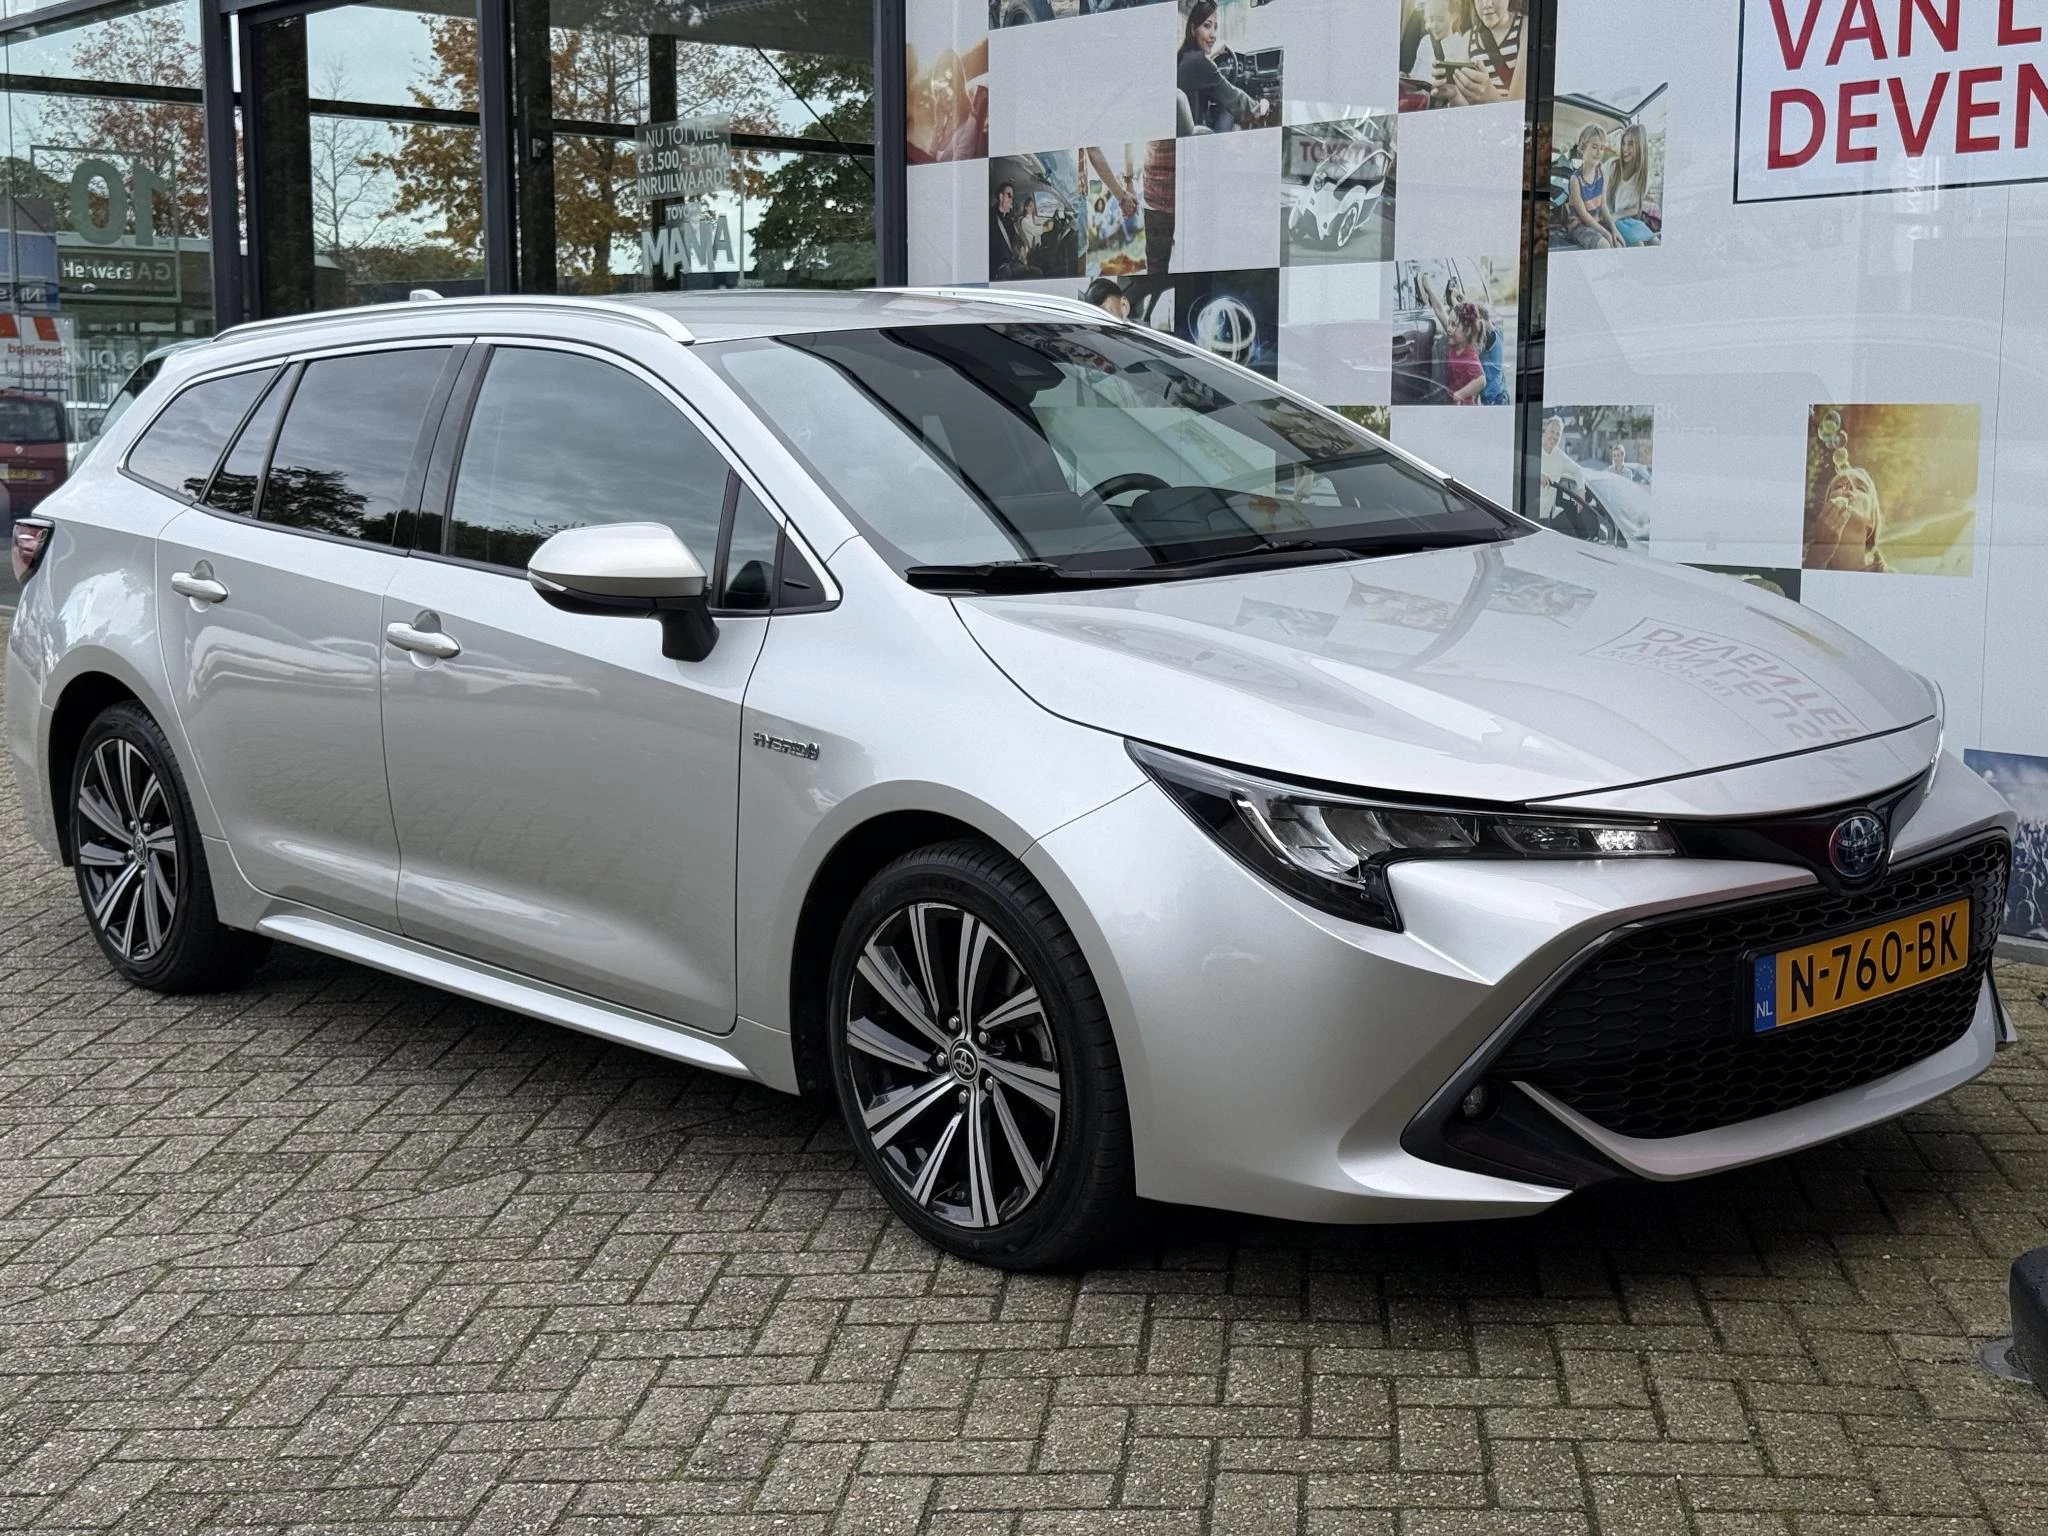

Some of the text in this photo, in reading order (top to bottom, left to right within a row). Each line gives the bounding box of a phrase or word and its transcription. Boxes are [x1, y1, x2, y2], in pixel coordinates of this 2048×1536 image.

[1769, 0, 1961, 71] VAN
[645, 125, 720, 149] NU TOT WEL
[637, 166, 731, 197] INRUILWAARDE
[1790, 911, 1959, 1013] N-760-BK
[1756, 1001, 1774, 1019] NL
